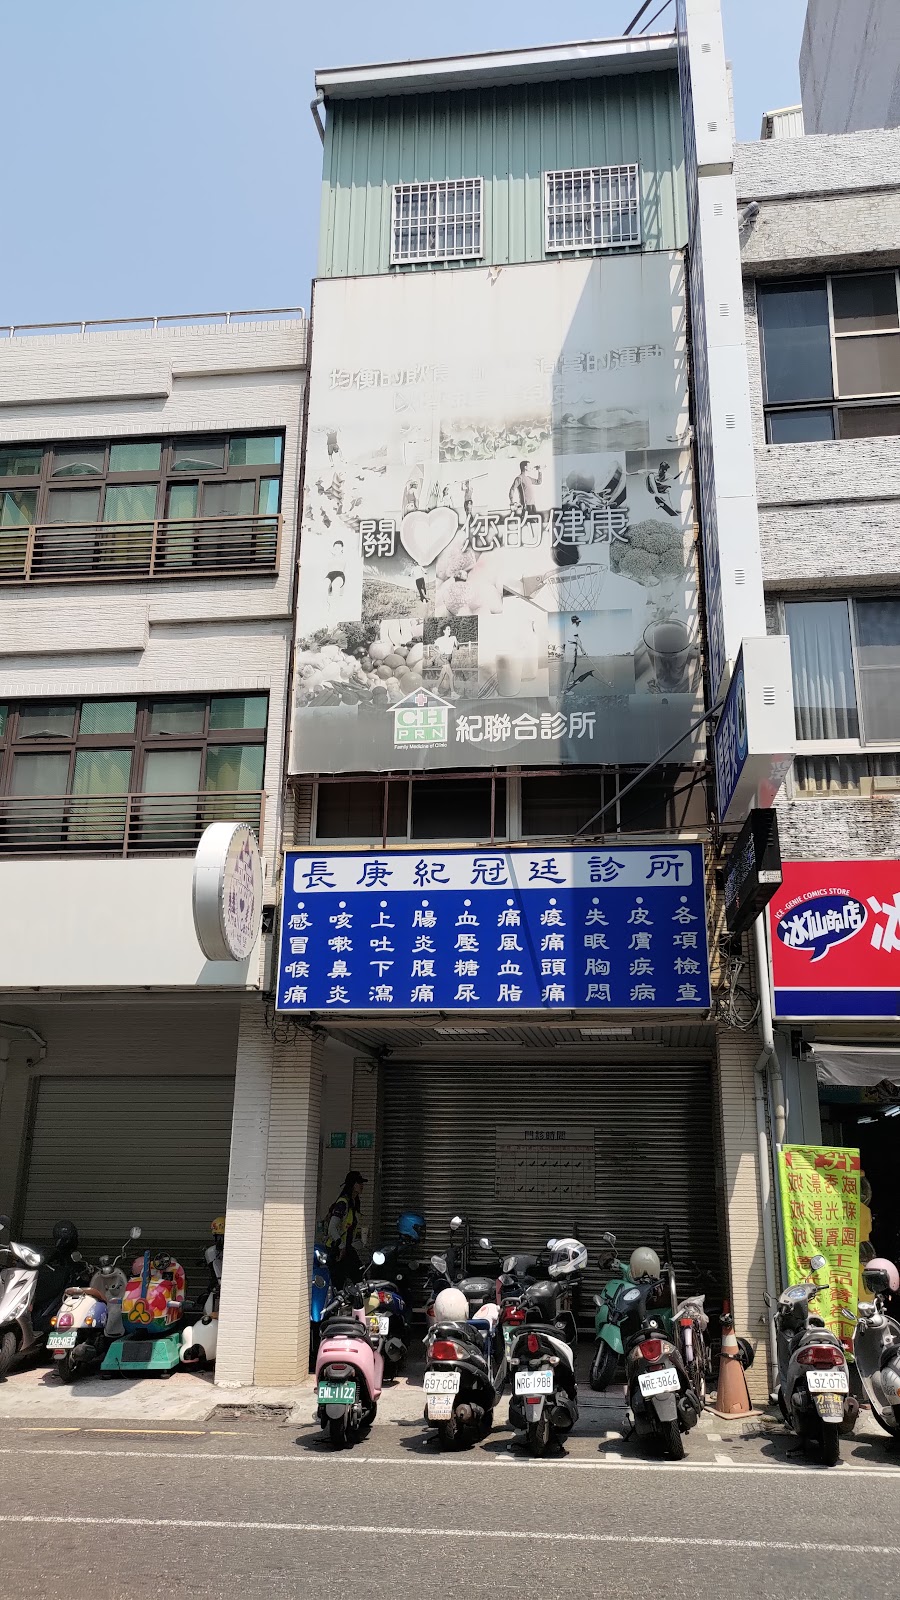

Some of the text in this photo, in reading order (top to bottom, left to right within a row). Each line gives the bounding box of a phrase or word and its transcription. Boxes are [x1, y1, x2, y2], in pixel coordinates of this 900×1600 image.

[359, 507, 631, 558] 關 您的健康
[398, 728, 443, 740] PRN
[455, 711, 597, 743] 紀聯合診所
[301, 854, 684, 889] 長庚紀冠廷診所
[775, 908, 785, 920] ICE
[802, 888, 828, 901] COMICS
[828, 887, 851, 897] STORE
[283, 912, 313, 1004] 感冒喉痛
[325, 911, 354, 1004] 咳嗽鼻炎
[368, 911, 396, 1003] 上吐下瀉
[410, 910, 438, 1003] 腸炎腹痛
[453, 910, 480, 1003] 血壓糖尿
[497, 908, 524, 1002] 痛風血脂
[540, 908, 567, 1002] 痠痛頭痛
[584, 908, 611, 1002] 失眠胸悶
[627, 907, 657, 1001] 皮膚疾病
[671, 906, 702, 1002] 各項檢查
[524, 1130, 567, 1141] 門診時間
[424, 1379, 459, 1390] 697-CCH
[640, 1373, 678, 1391] MRE-3866
